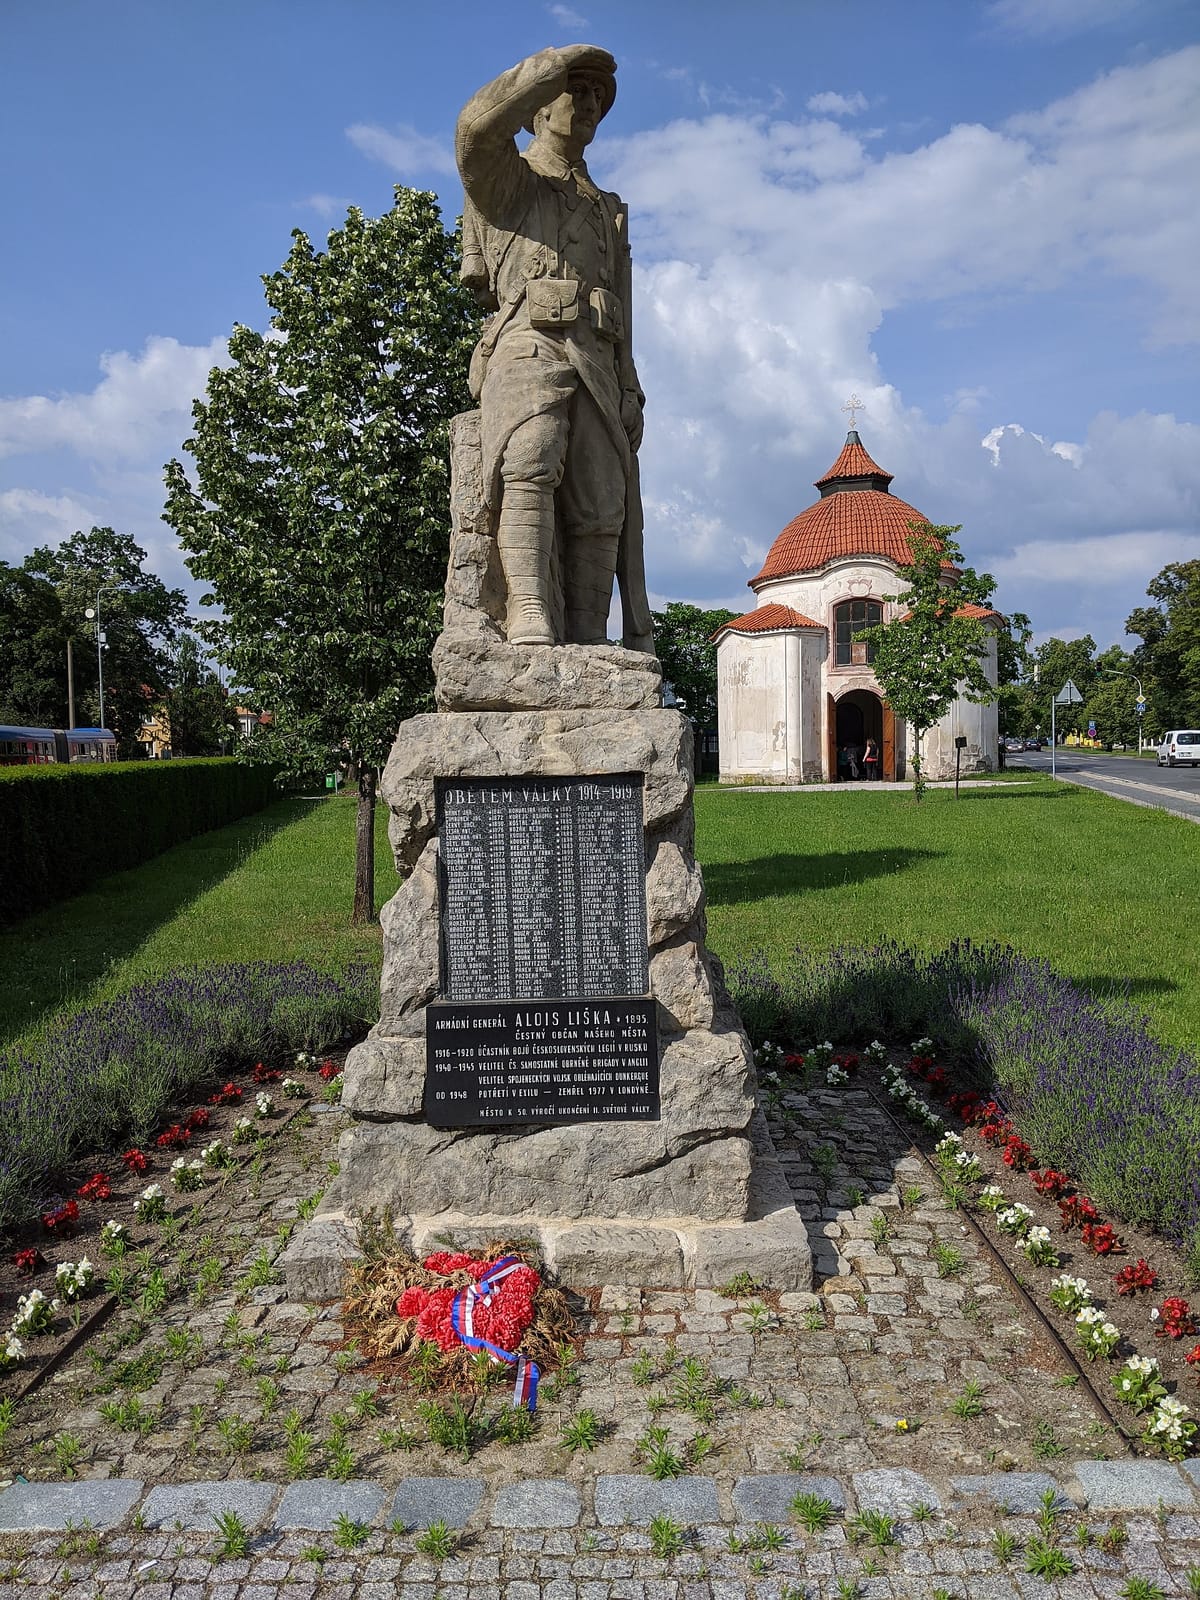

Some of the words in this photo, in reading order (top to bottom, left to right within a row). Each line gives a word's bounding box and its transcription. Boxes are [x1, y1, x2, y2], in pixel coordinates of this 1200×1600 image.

[522, 784, 571, 802] VÁLKY
[436, 1016, 469, 1030] ARMÁDNÍ
[473, 1014, 507, 1028] GENERÁL
[516, 1012, 559, 1026] ALOIS
[568, 1008, 610, 1026] LIŠKA
[516, 1028, 546, 1040] ČESTNÝ
[552, 1028, 578, 1039] OBČAN
[584, 1027, 614, 1038] NAŠEHO
[622, 1026, 646, 1038] MĚSTA
[618, 1044, 622, 1052] V
[624, 1043, 648, 1052] RUSKU
[478, 1062, 504, 1070] VELITEL
[622, 1058, 626, 1066] V
[628, 1058, 648, 1066] ANGLII
[478, 1076, 504, 1084] VELITEL
[508, 1072, 550, 1084] SPOJENECKÝCH
[553, 1074, 572, 1082] VOJSK
[436, 1092, 446, 1100] OD
[450, 1090, 468, 1100] 1948
[478, 1086, 508, 1098] POTŘETÍ
[520, 1088, 539, 1097] EXILU
[558, 1084, 584, 1096] ZEMŘEL
[588, 1086, 606, 1095] 1977
[610, 1086, 614, 1094] V
[480, 1106, 504, 1116] MĚSTO
[558, 1104, 590, 1114] UKONČENÍ
